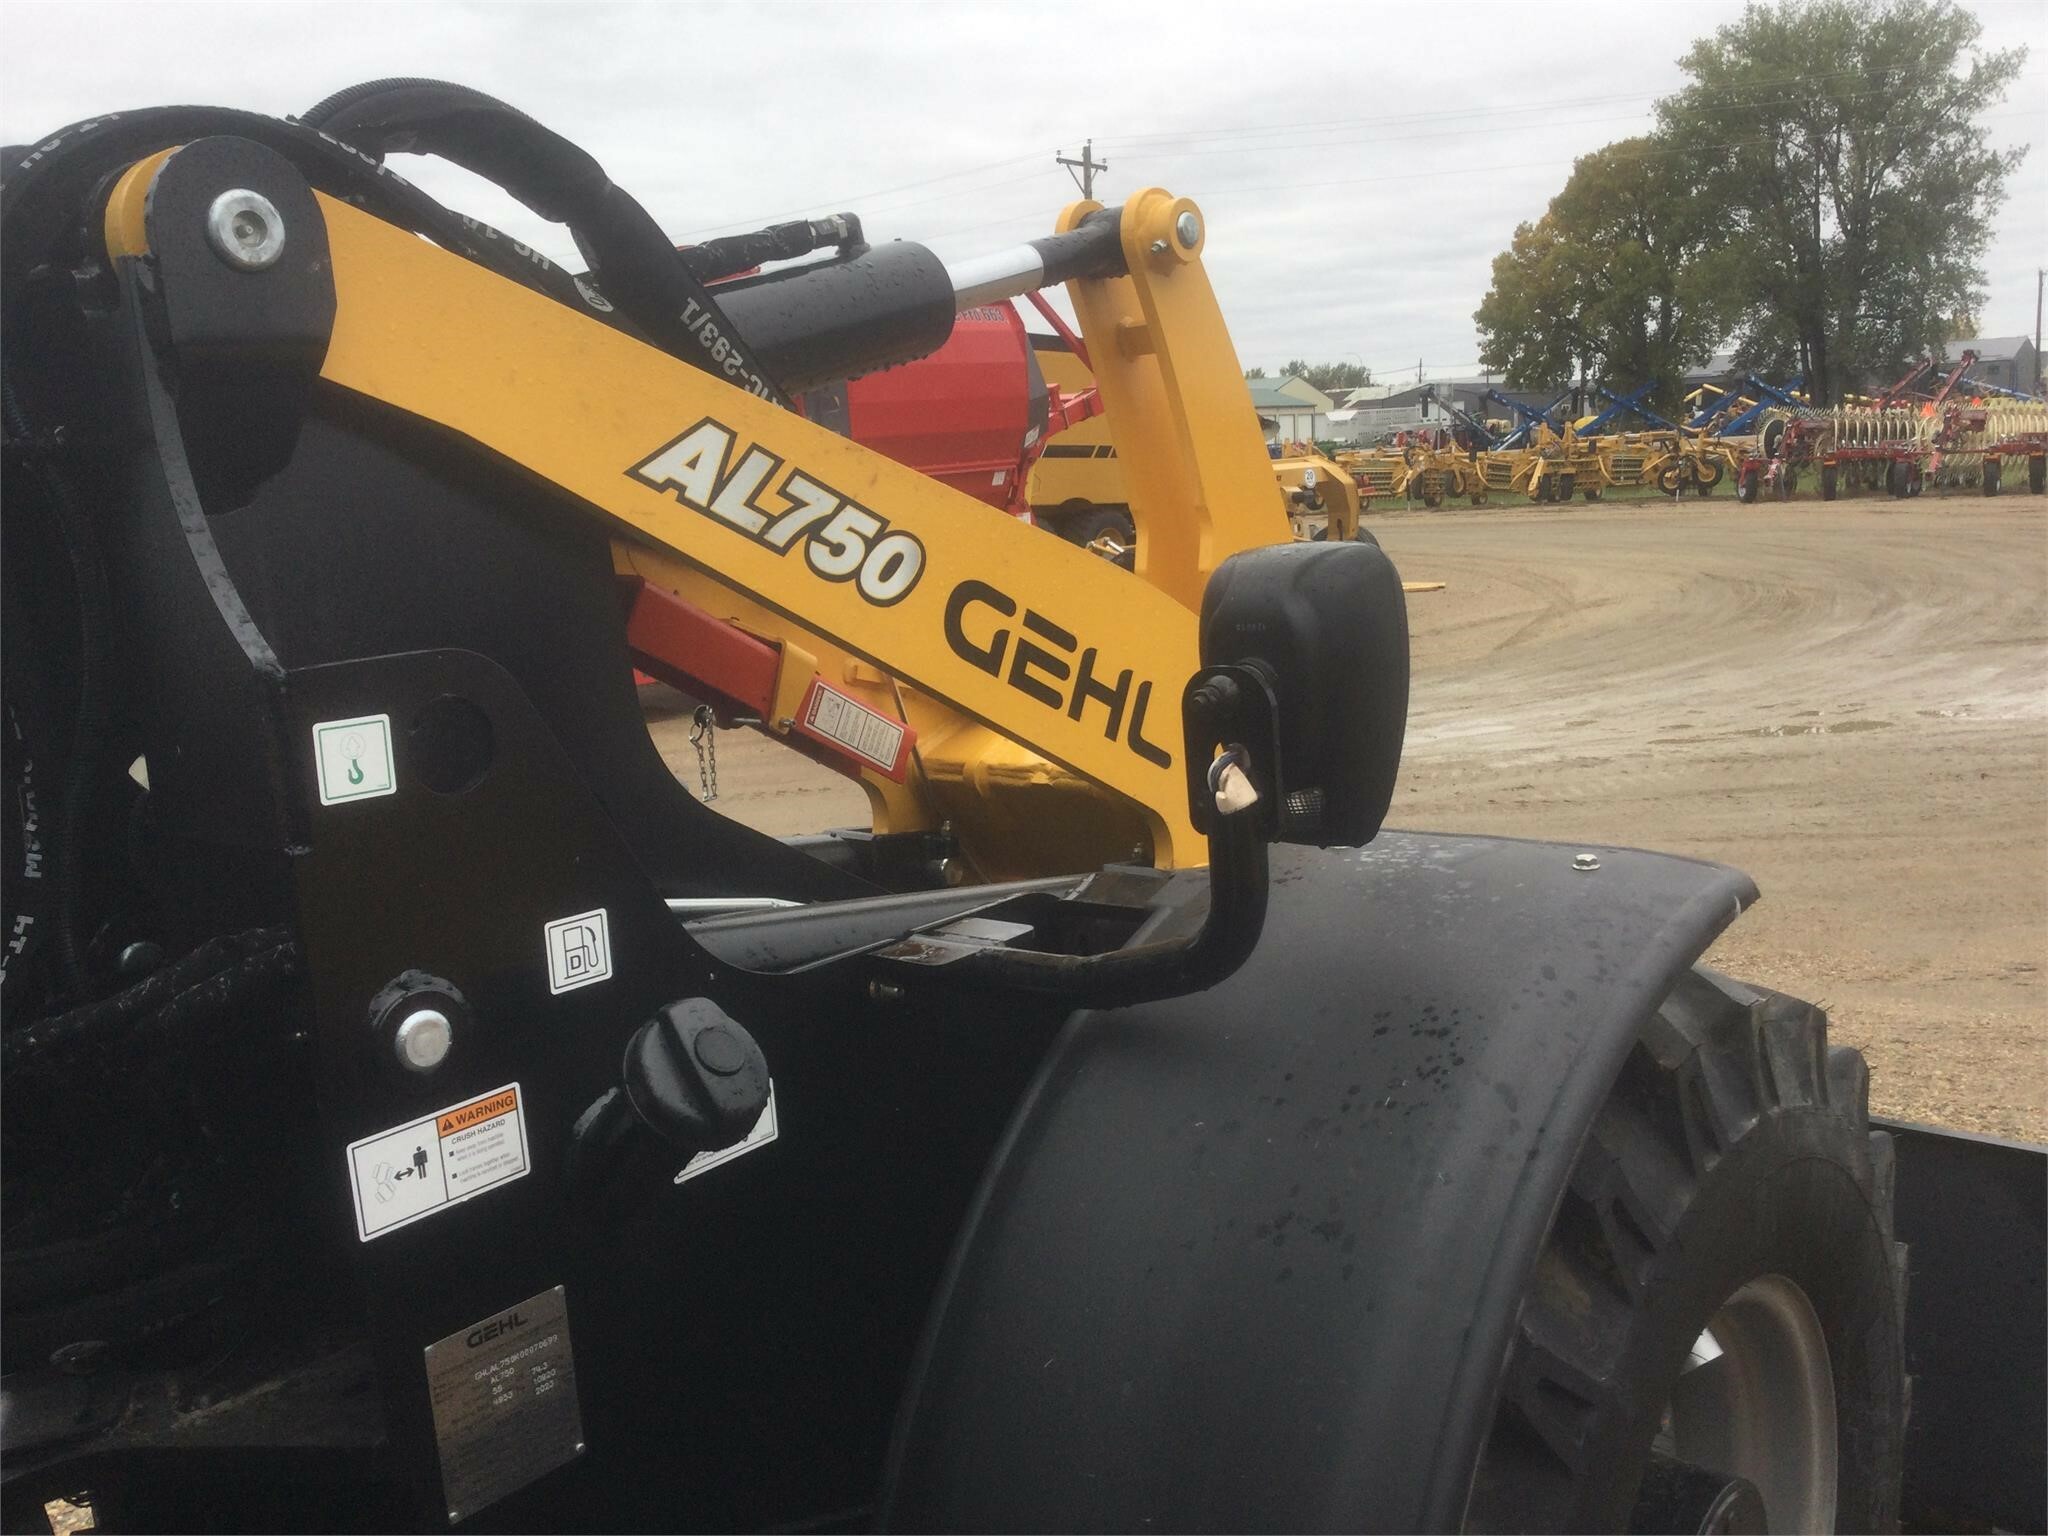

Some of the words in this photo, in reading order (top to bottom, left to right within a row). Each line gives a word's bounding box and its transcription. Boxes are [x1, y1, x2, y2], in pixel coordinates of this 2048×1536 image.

[1305, 471, 1314, 480] 20
[623, 416, 926, 607] AL750
[944, 580, 1171, 769] GEHL
[456, 1095, 514, 1125] WARNING
[451, 1129, 476, 1145] CRUSH
[477, 1119, 506, 1135] HAZARD
[466, 1312, 528, 1349] GEHL
